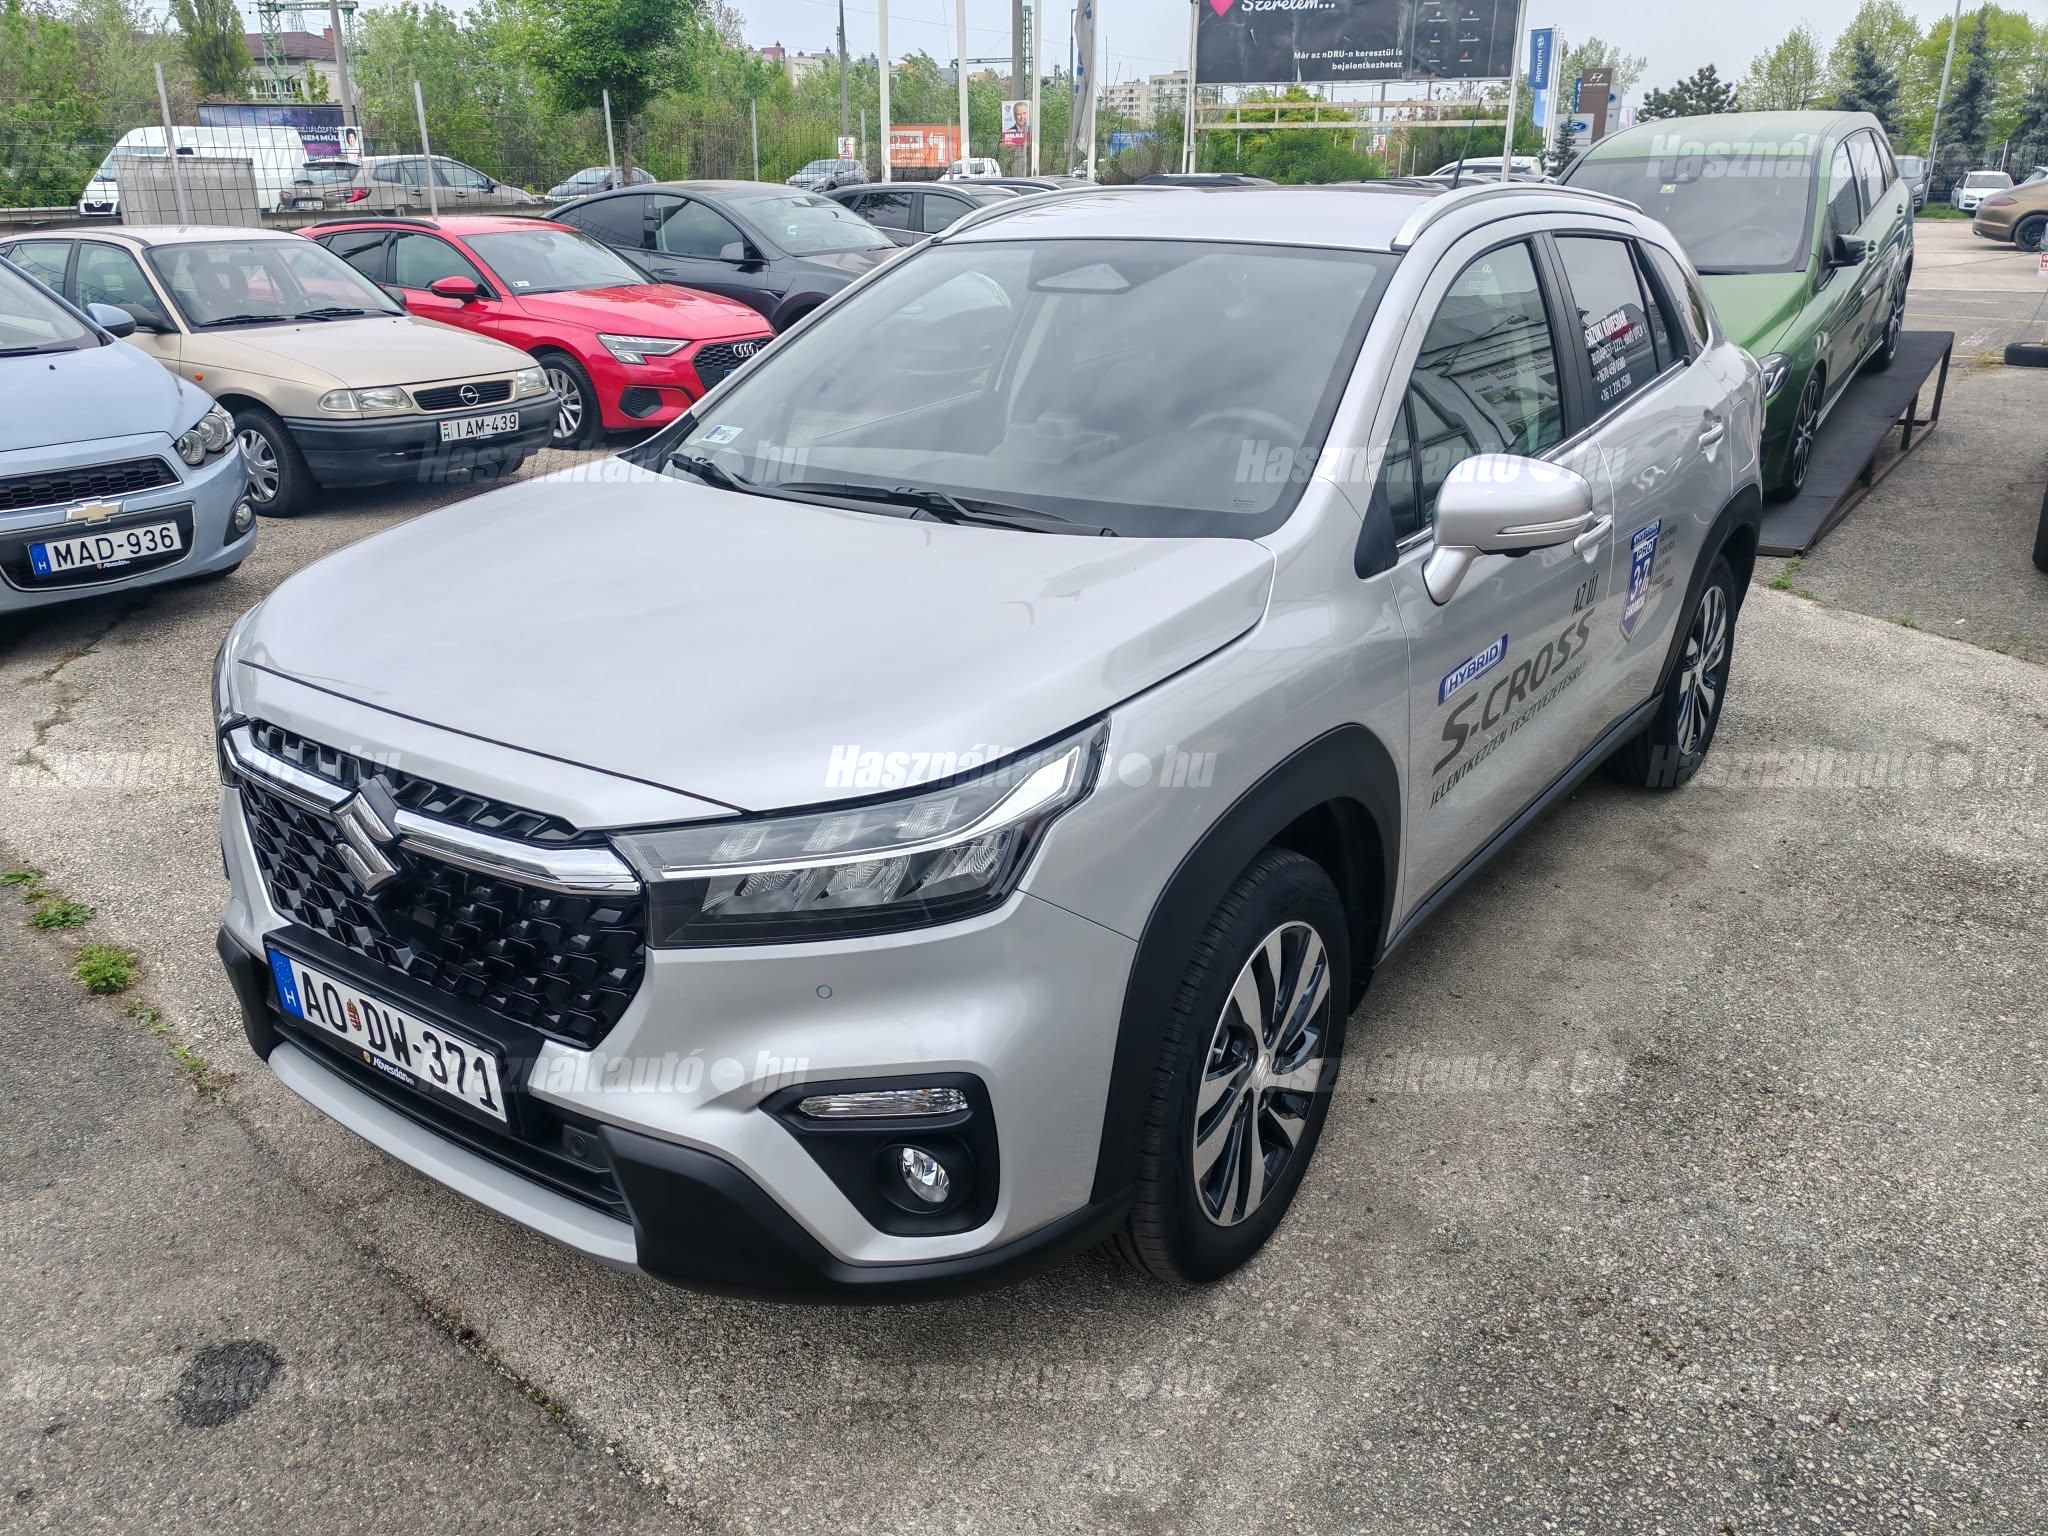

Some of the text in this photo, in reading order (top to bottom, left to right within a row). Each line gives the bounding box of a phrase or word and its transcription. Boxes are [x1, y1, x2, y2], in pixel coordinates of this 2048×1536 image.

[38, 526, 174, 571] H MAD-936
[1448, 644, 1499, 694] HYBRID
[1429, 727, 1508, 811] JELENTKEZZEN
[284, 970, 499, 1113] H AO DW-371
